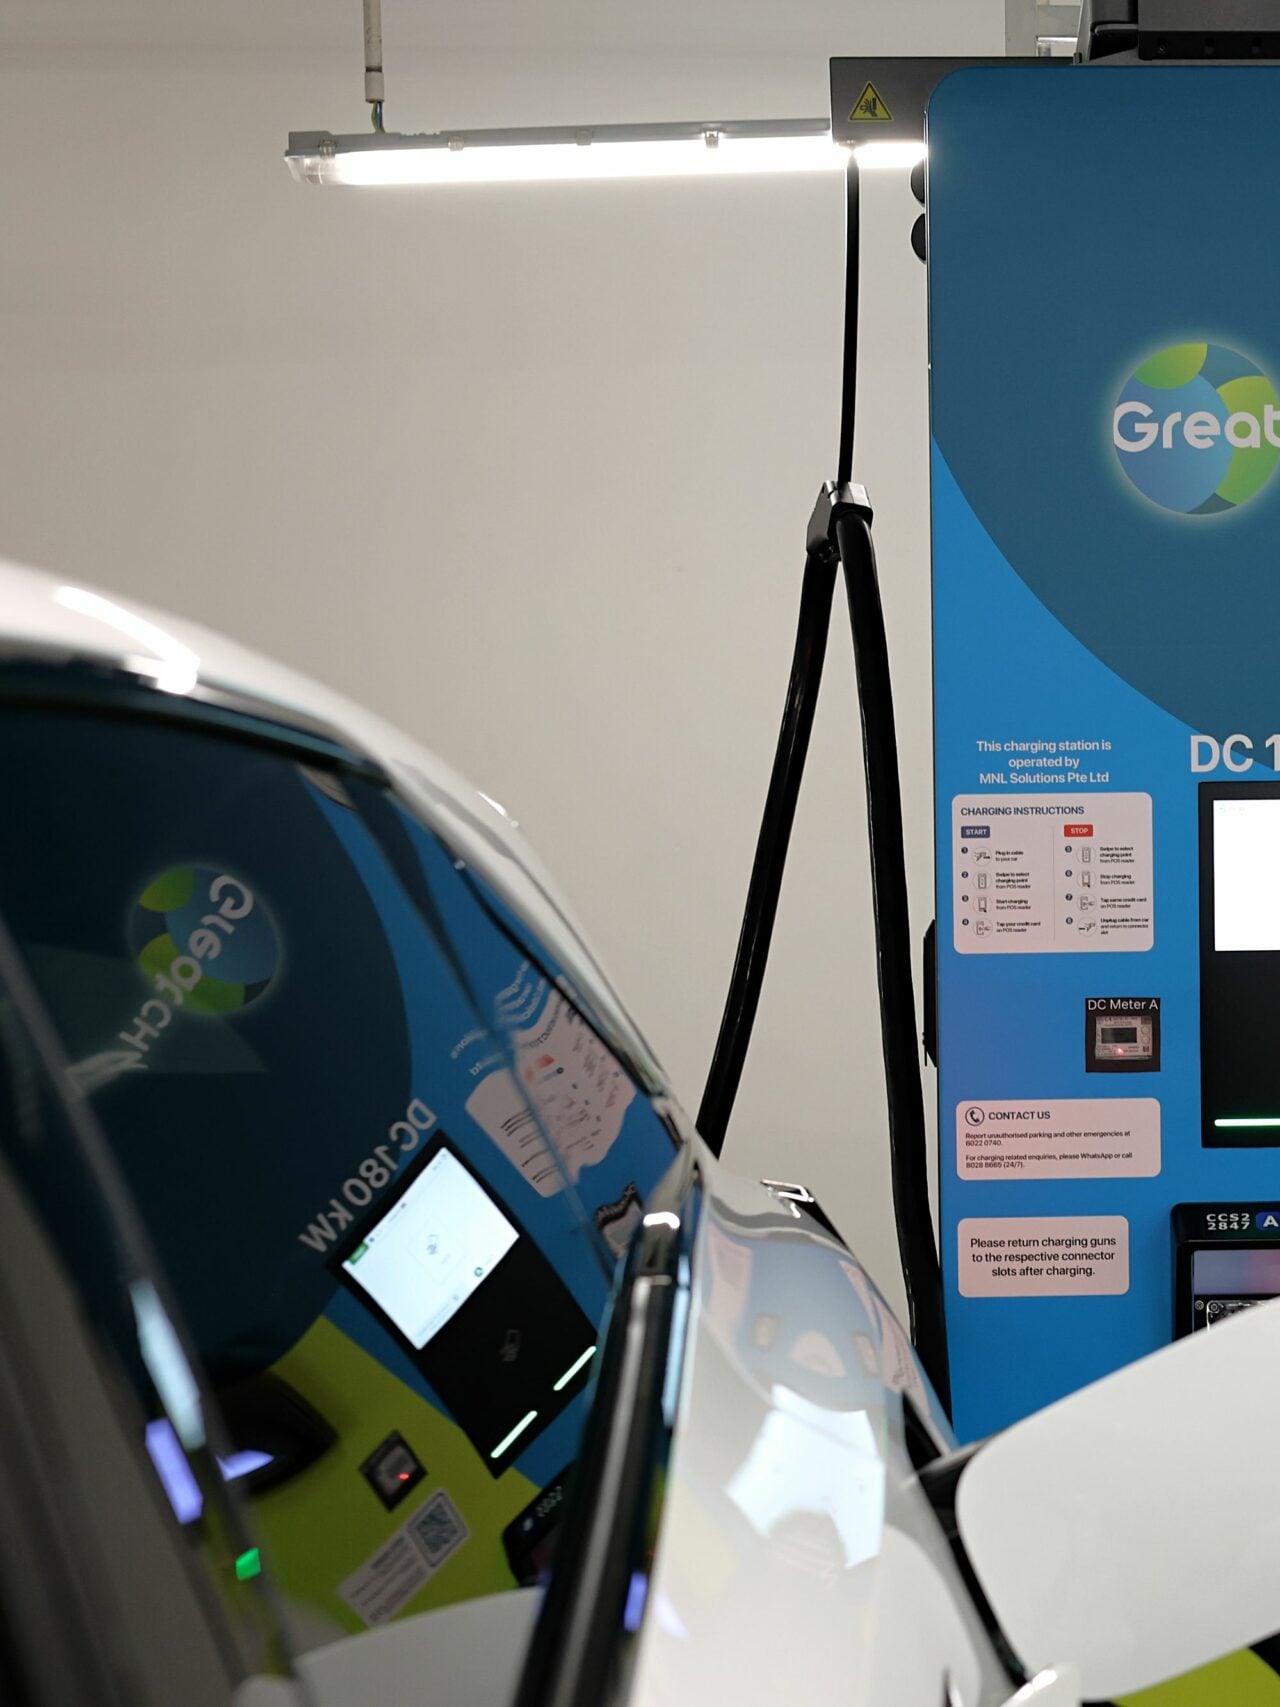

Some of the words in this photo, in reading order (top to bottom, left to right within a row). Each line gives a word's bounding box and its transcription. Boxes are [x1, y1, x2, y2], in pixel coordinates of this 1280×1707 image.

[976, 740, 1001, 752] This
[1003, 740, 1057, 753] charging
[1058, 740, 1100, 751] station
[1101, 739, 1112, 751] is
[1190, 734, 1254, 773] DC
[1008, 756, 1062, 769] operated
[1064, 756, 1080, 769] by
[980, 773, 1008, 784] MNL
[1010, 772, 1065, 784] Solutions
[1067, 772, 1088, 783] Pte
[1089, 771, 1109, 783] Ltd
[960, 807, 1012, 816] CHARGING
[1013, 806, 1085, 816] INSTRUCTIONS
[965, 828, 987, 836] START
[1088, 999, 1107, 1010] DC
[1110, 999, 1146, 1010] Meter
[1149, 999, 1159, 1010] A
[988, 1112, 1036, 1120] CONTACT
[1037, 1111, 1051, 1120] US
[1083, 1130, 1123, 1138] emergencies
[1206, 1213, 1250, 1222] CCS2
[1263, 1215, 1279, 1227] A
[1207, 1222, 1250, 1230] 2847
[970, 1238, 1005, 1248] Please
[1008, 1238, 1040, 1247] return
[1041, 1237, 1088, 1248] charging
[1090, 1238, 1116, 1248] guns
[972, 1254, 983, 1262] to
[985, 1253, 1002, 1262] the
[1004, 1252, 1060, 1263] respective
[1061, 1251, 1115, 1261] connector
[992, 1267, 1017, 1277] slots
[1019, 1266, 1044, 1276] after
[1046, 1265, 1096, 1277] charging.
